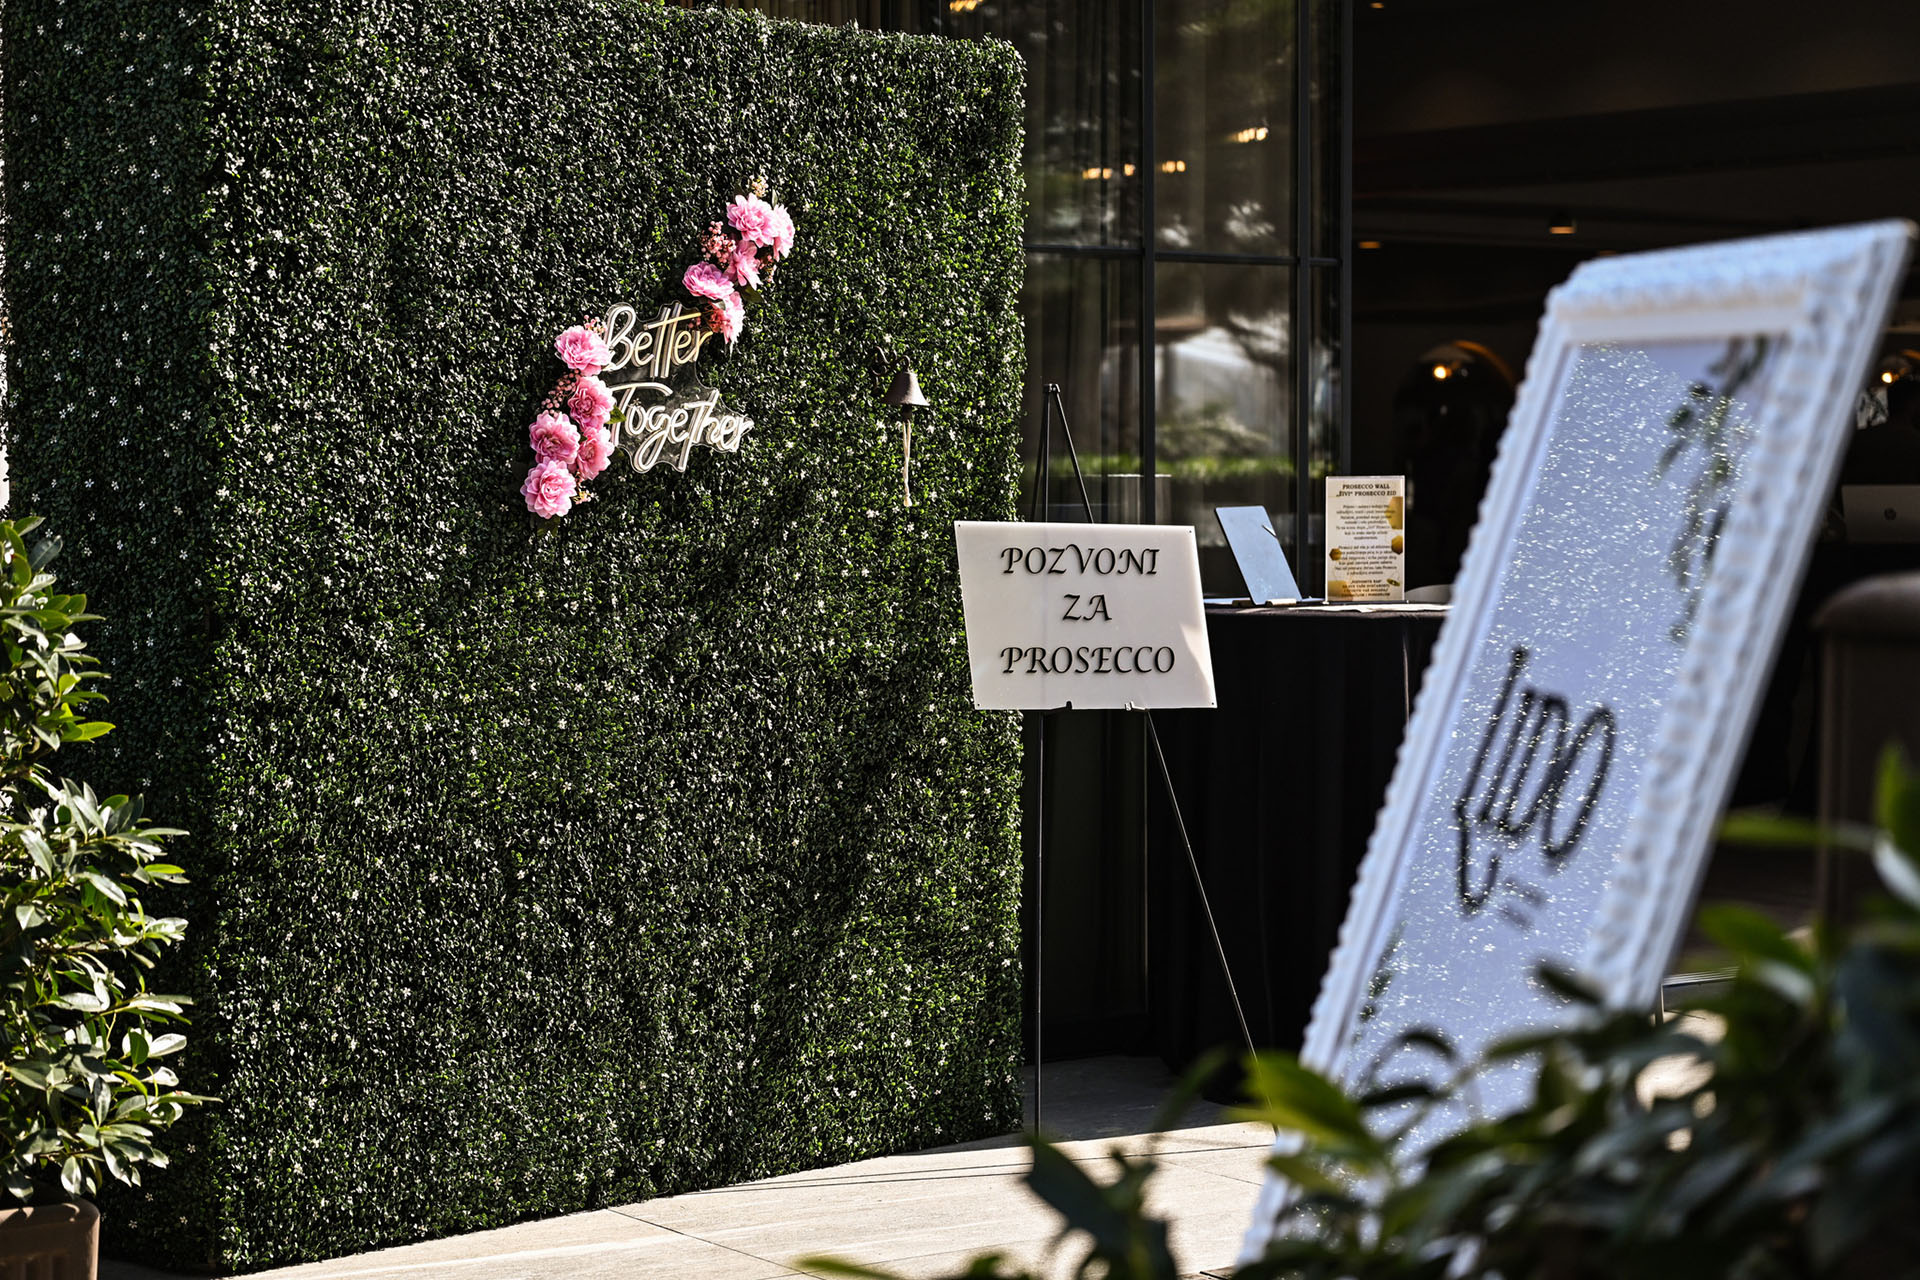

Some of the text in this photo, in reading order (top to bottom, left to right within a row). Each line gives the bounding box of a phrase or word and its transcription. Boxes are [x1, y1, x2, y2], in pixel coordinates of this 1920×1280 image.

[602, 302, 713, 378] Better
[609, 382, 754, 472] Together
[1001, 544, 1160, 575] POZVONI
[1063, 594, 1112, 621] ZA
[1000, 646, 1176, 674] PROSECCO
